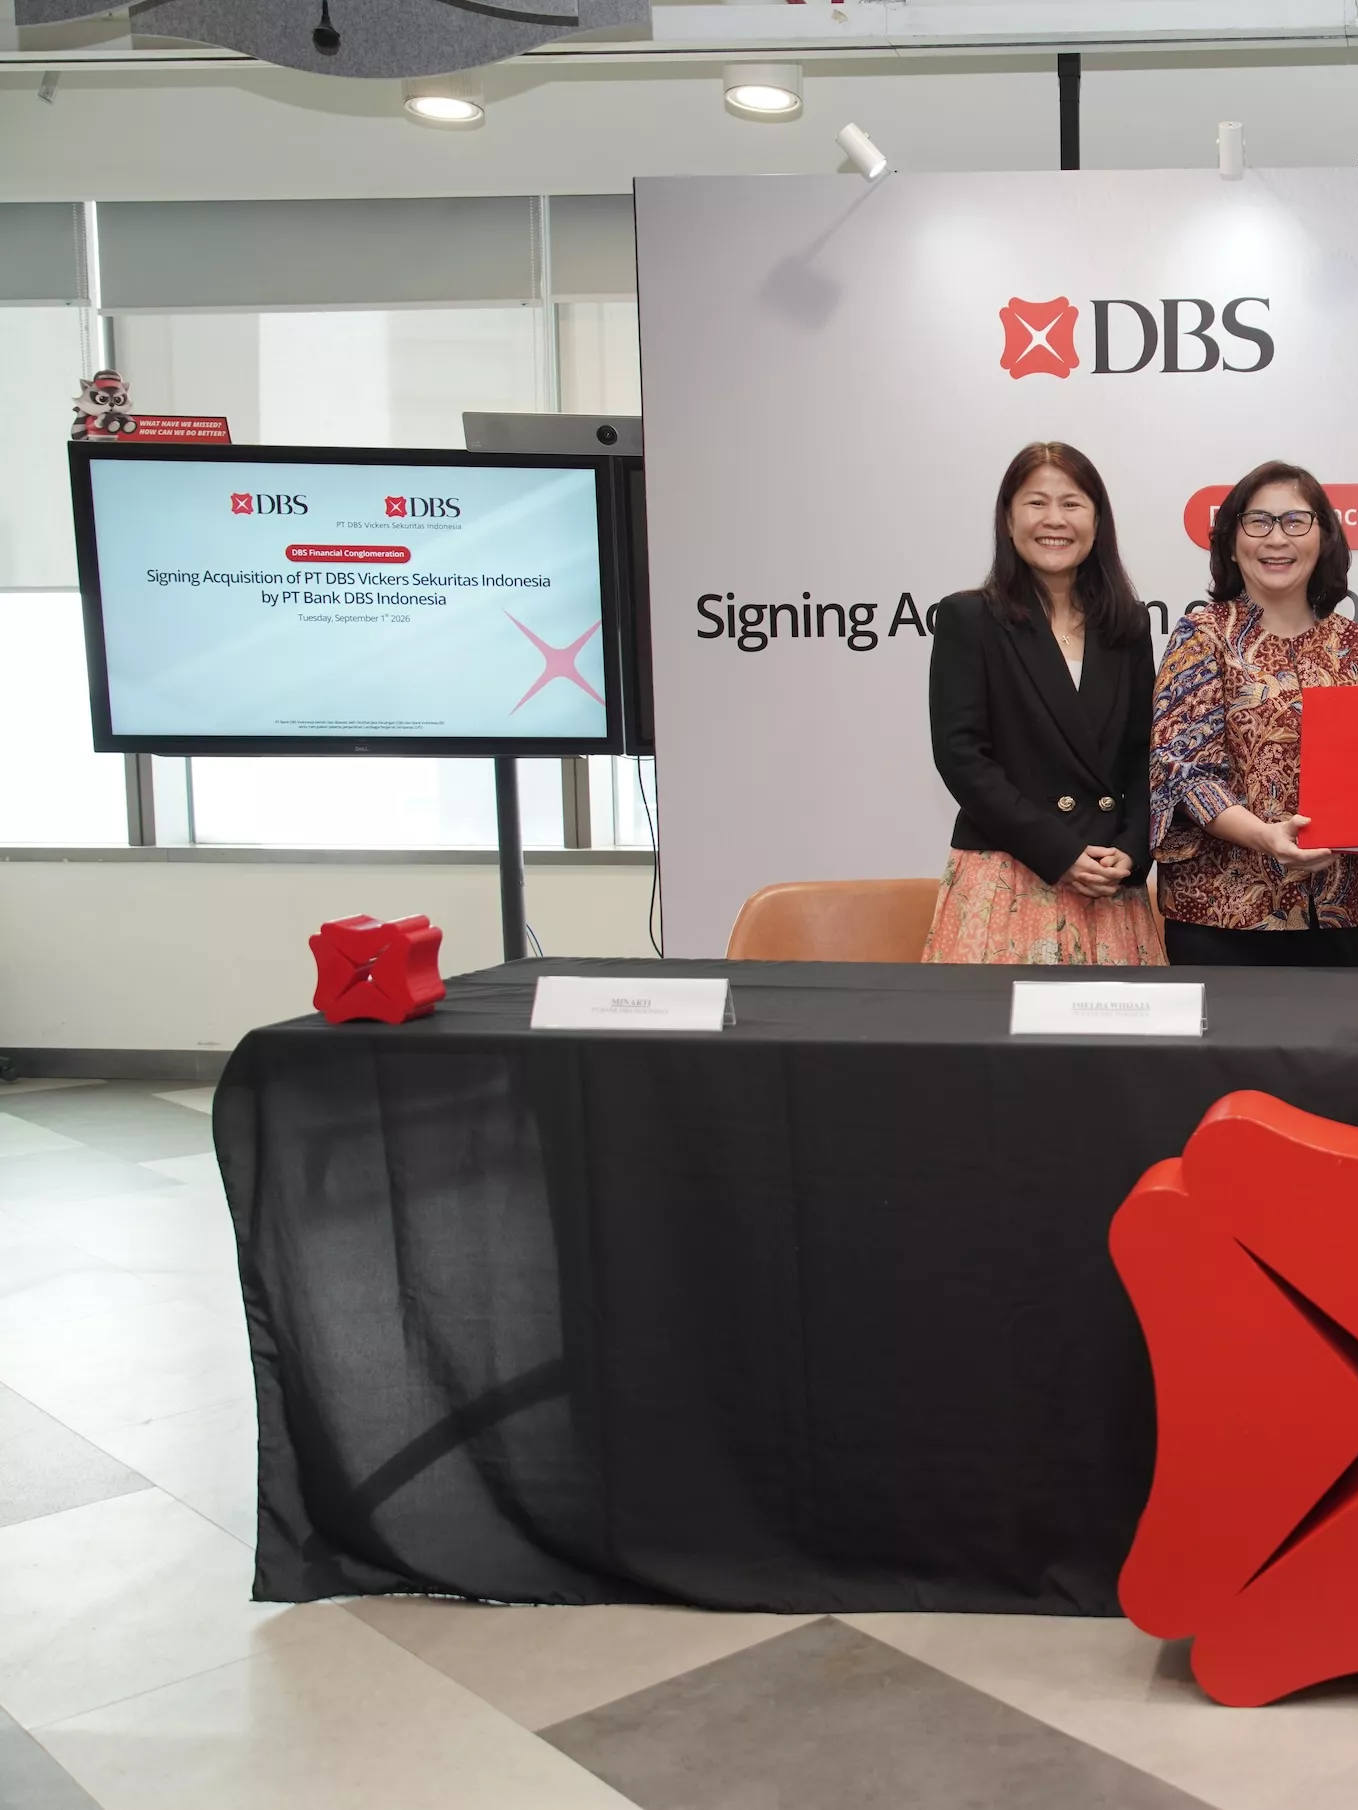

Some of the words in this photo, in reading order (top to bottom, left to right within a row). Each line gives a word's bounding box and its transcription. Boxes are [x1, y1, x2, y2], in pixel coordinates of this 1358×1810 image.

[1090, 297, 1274, 374] DBS
[256, 494, 308, 515] DBS
[410, 497, 460, 518] DBS
[392, 522, 425, 530] Sekuritas
[309, 549, 342, 557] Financial
[344, 550, 404, 558] Conglomeration
[147, 570, 200, 586] Signing
[203, 570, 283, 587] Acquisition
[287, 571, 301, 584] of
[305, 572, 322, 584] PT
[326, 572, 355, 585] DBS
[358, 572, 410, 586] Vickers
[412, 573, 479, 586] Sekuritas
[482, 574, 551, 587] Indonesia
[262, 590, 279, 607] by
[283, 591, 300, 604] PT
[304, 591, 341, 604] Bank
[344, 592, 373, 605] DBS
[377, 592, 446, 605] Indonesia
[298, 614, 333, 623] Tuesday,
[335, 614, 378, 623] September
[391, 615, 410, 623] 2026
[696, 592, 878, 652] Signing
